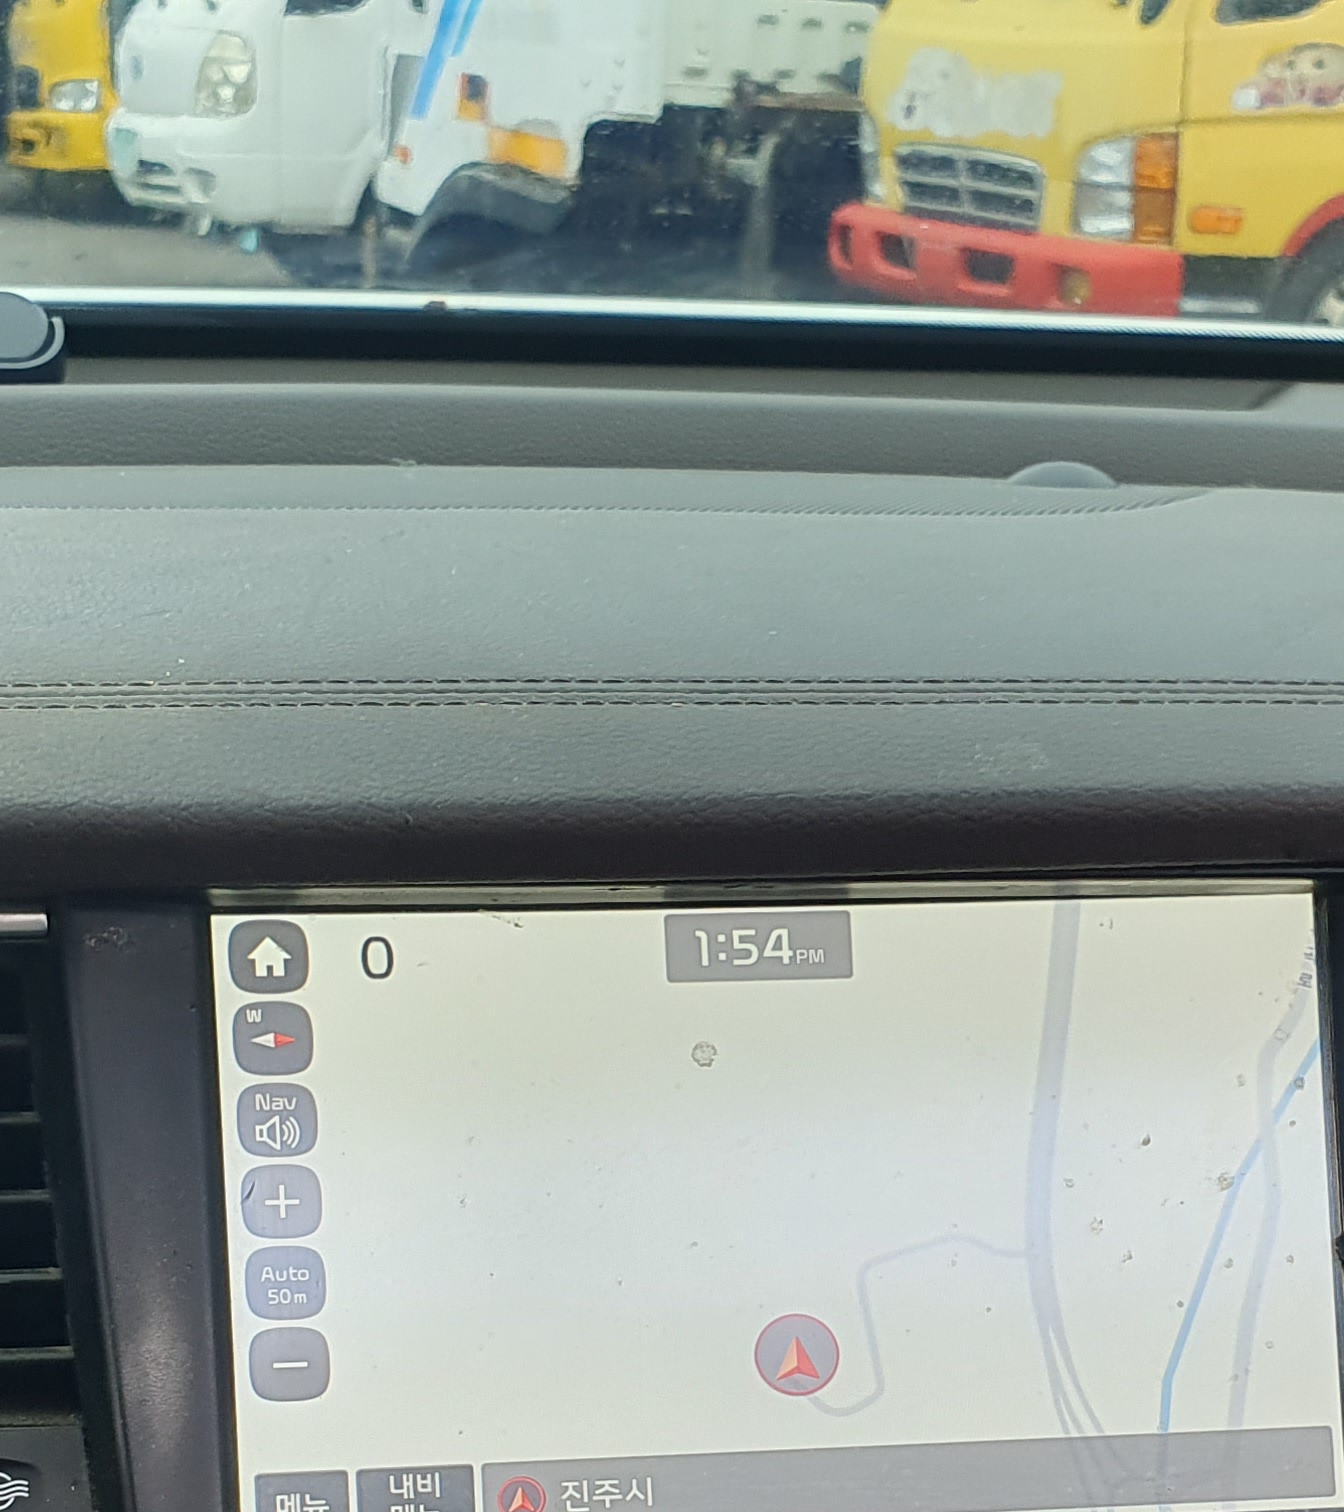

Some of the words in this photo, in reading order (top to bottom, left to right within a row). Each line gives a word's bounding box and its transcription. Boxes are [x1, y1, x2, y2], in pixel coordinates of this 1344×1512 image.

[361, 936, 394, 979] 0
[246, 1009, 262, 1023] W
[255, 1094, 297, 1111] Nav
[260, 1266, 310, 1282] Auto
[389, 1472, 441, 1500] 내비
[560, 1477, 653, 1512] 진주시
